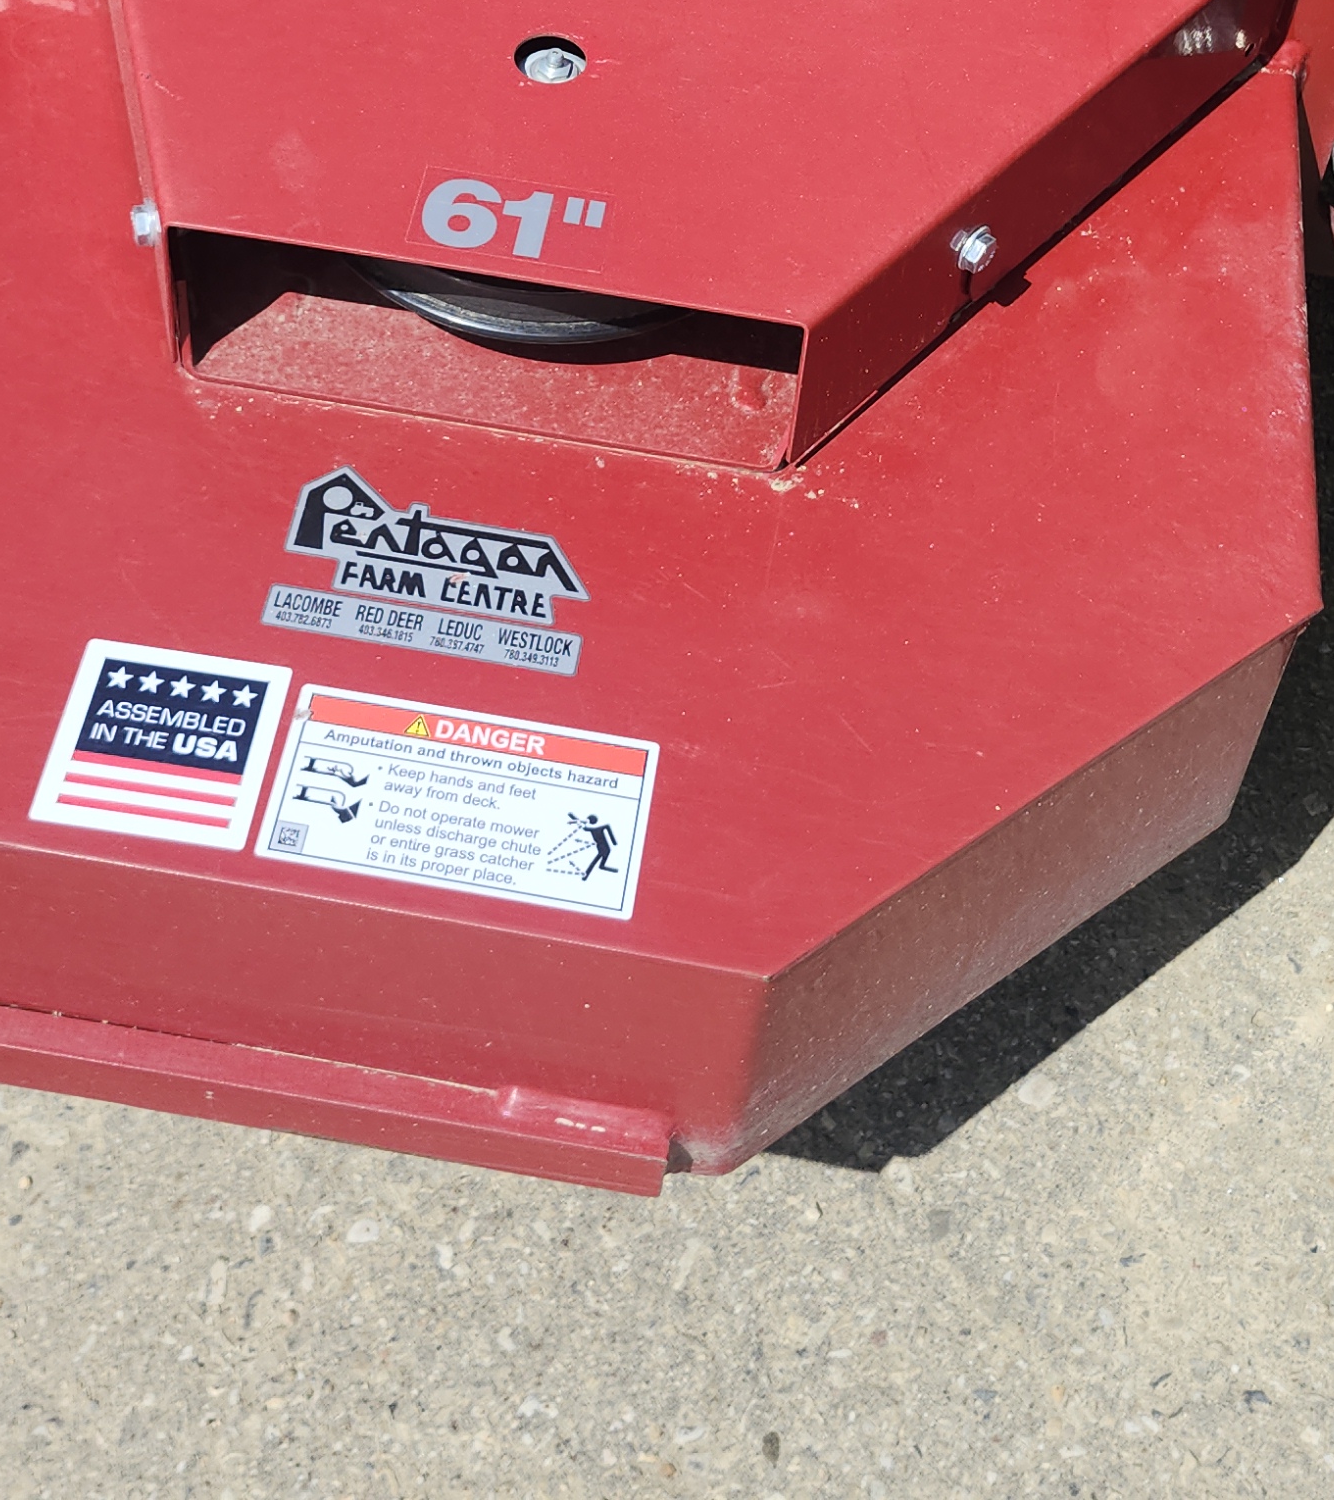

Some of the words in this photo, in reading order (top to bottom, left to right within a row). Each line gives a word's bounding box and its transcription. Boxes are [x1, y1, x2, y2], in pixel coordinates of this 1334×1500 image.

[421, 178, 607, 260] 61"
[294, 473, 579, 593] Pentagon
[340, 561, 427, 599] FARM
[440, 577, 548, 619] CENTRE
[273, 591, 343, 617] LACOMBE
[355, 604, 384, 625] RED
[387, 610, 424, 631] DEER
[437, 618, 483, 641] LEDUC
[498, 627, 573, 657] WESTLOCK
[96, 699, 246, 737] ASSEMBLED
[435, 719, 545, 755] DANGER
[89, 722, 118, 743] IN
[123, 726, 169, 750] THE
[172, 735, 238, 762] USA
[324, 729, 412, 754] Amputation
[417, 746, 446, 759] and
[450, 750, 502, 769] thrown
[508, 761, 562, 779] objects
[567, 769, 619, 789] hazard
[384, 781, 422, 798] away
[426, 786, 459, 802] from
[463, 793, 500, 810] deck.
[388, 763, 425, 782] Keep
[429, 770, 474, 789] hands
[478, 781, 505, 794] and
[509, 784, 537, 800] feet
[374, 818, 422, 835] unless
[426, 825, 497, 849] discharge
[501, 839, 541, 856] chute
[378, 800, 400, 815] Do
[403, 805, 427, 820] not
[430, 811, 486, 830] operate
[490, 821, 540, 839] mower
[366, 847, 379, 861] is
[382, 850, 396, 865] in
[399, 852, 417, 868] its
[420, 859, 470, 877] proper
[472, 868, 517, 886] place.
[370, 834, 386, 846] or
[390, 837, 431, 853] entire
[434, 845, 475, 861] grass
[479, 852, 535, 871] catcher
